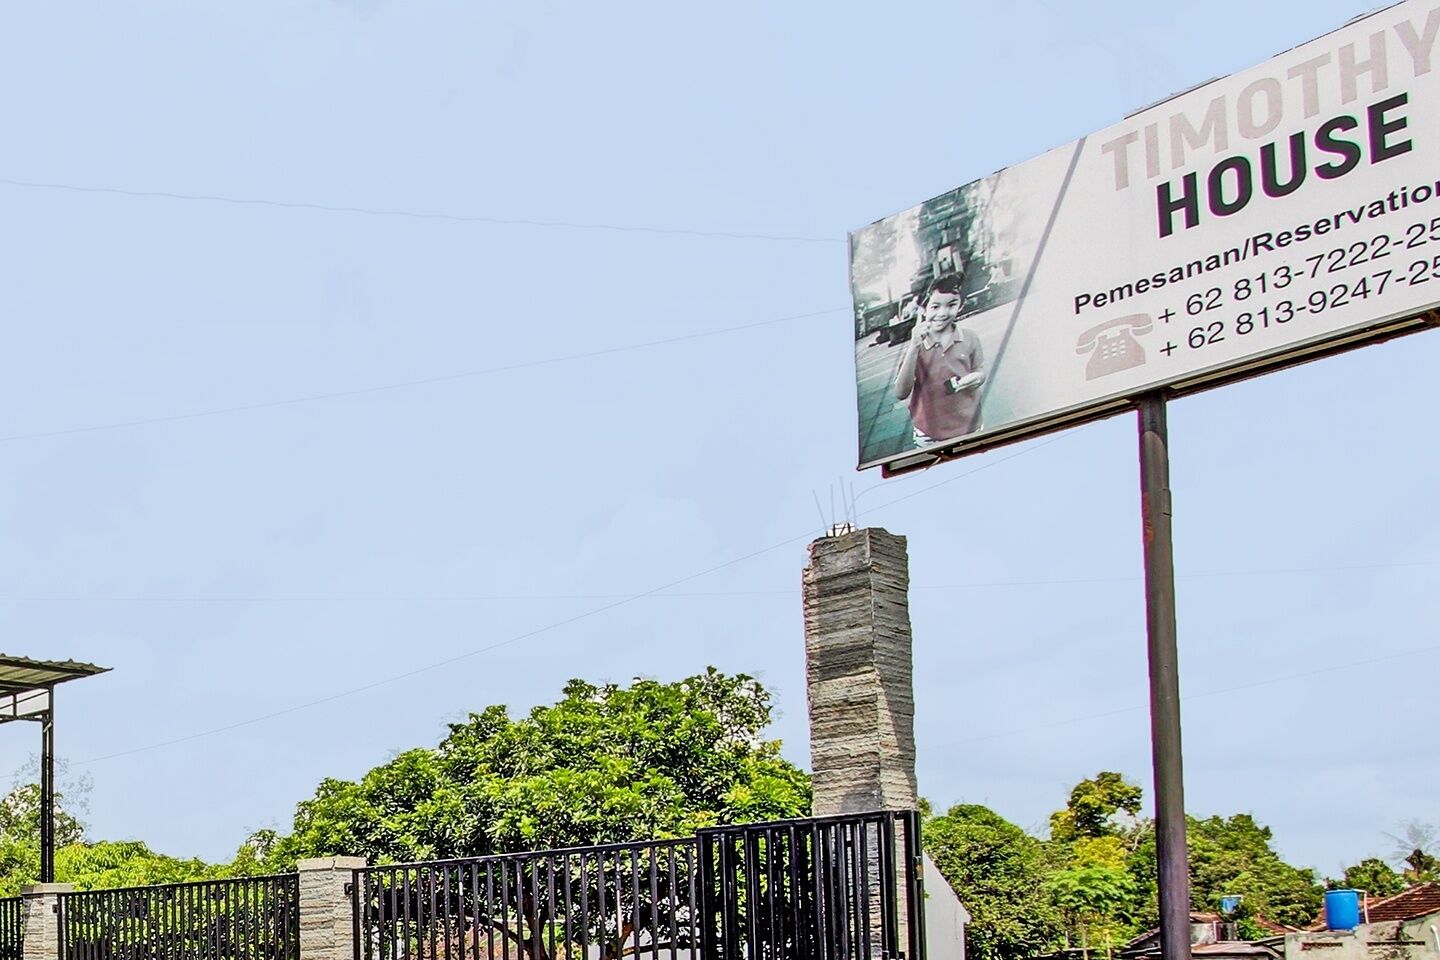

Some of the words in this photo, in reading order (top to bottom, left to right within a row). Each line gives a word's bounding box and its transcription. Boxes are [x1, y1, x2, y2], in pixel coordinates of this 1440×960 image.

[1101, 7, 1440, 191] TIMOTHY
[1157, 92, 1413, 238] HOUSE
[1074, 181, 1440, 314] Pemesanan/Reservatio
[1186, 287, 1223, 316] 62
[1188, 323, 1225, 350] 62
